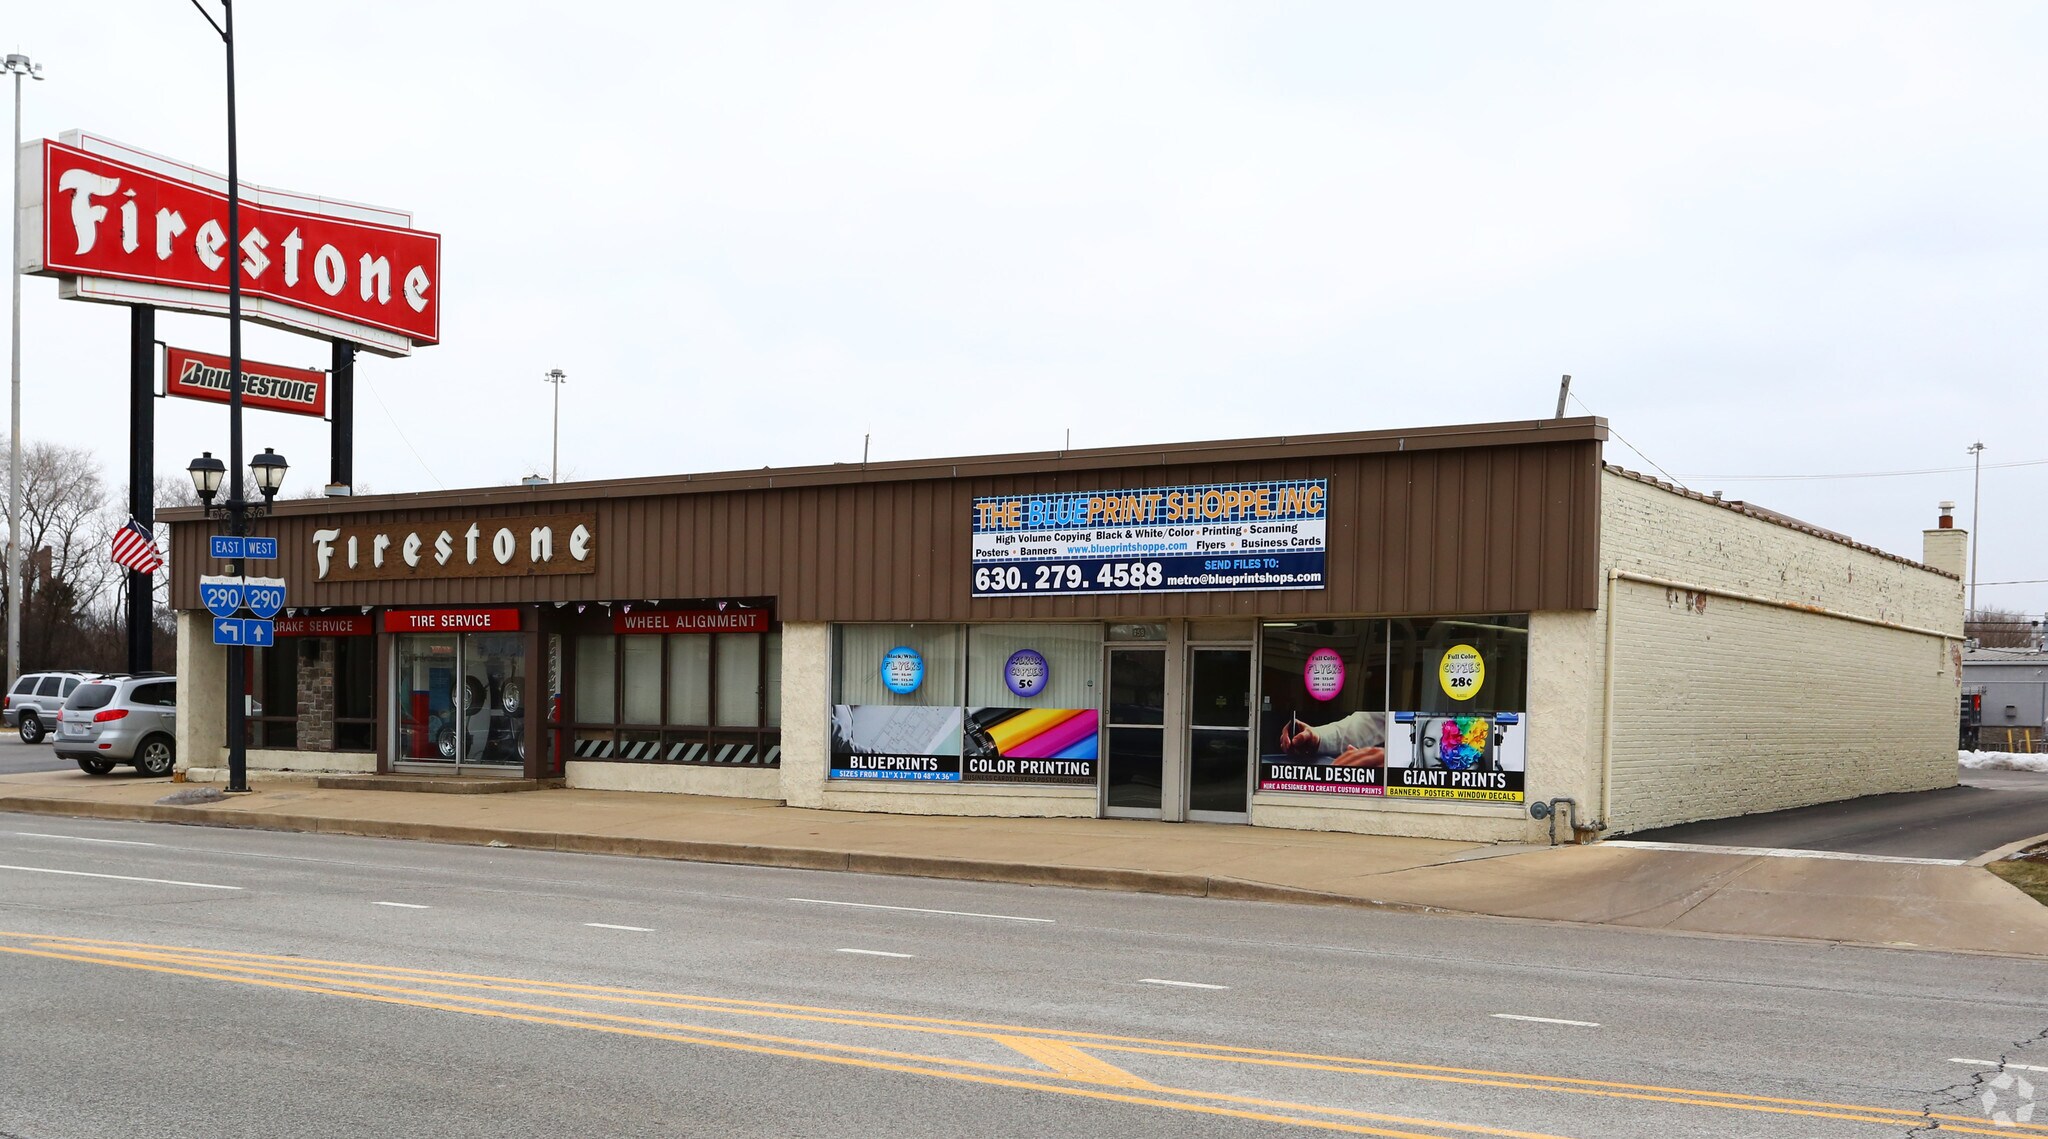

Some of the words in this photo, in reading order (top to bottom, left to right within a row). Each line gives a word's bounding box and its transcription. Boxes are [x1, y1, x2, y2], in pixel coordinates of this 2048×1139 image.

[58, 168, 431, 313] Firestone
[976, 501, 1021, 529] THE
[1028, 494, 1162, 527] BLUEPRINT
[995, 535, 1016, 545] High
[1018, 533, 1052, 543] Volume
[1054, 531, 1092, 543] Copying
[1096, 530, 1123, 540] Black
[1125, 530, 1133, 539] &
[1202, 526, 1242, 537] Printing
[1250, 523, 1298, 534] Scanning
[216, 541, 239, 553] EAST
[249, 541, 272, 554] WEST
[312, 522, 591, 580] Firestone
[975, 548, 1009, 558] Posters
[1020, 547, 1057, 556] Banners
[1067, 541, 1188, 555] www.blueprintshoppe.com
[1196, 540, 1226, 551] Flyers
[1241, 538, 1288, 548] Business
[1291, 536, 1322, 546] Cards
[1204, 560, 1231, 570] SEND
[1233, 559, 1261, 570] FILES
[1263, 558, 1279, 569] TO:
[975, 566, 1028, 591] 630.
[1035, 564, 1089, 589] 279.
[1096, 562, 1163, 588] 4588
[1167, 572, 1322, 586] metro@blueprintshops.com
[207, 588, 239, 608] 290
[250, 589, 281, 609] 290
[309, 620, 353, 632] SERVICE
[410, 615, 435, 627] TIRE
[441, 614, 491, 627] SERVICE
[625, 616, 669, 628] WHEEL
[676, 614, 757, 628] ALIGNMENT
[884, 661, 922, 671] FLYERS
[1010, 667, 1044, 677] COPIES
[1307, 663, 1343, 675] FLYERS
[1443, 662, 1480, 674] COPIES
[1019, 679, 1033, 689] 5¢
[850, 756, 938, 771] BLUEPRINTS
[969, 758, 1015, 773] COLOR
[1020, 760, 1090, 776] PRINTING
[1271, 765, 1321, 780] DIGITAL
[1325, 767, 1375, 783] DESIGN
[1403, 770, 1447, 786] GIANT
[1452, 771, 1506, 788] PRINTS
[1281, 783, 1307, 791] DESIGNER
[1316, 785, 1337, 793] CREATE
[1337, 786, 1360, 794] CUSTOM
[1361, 787, 1382, 795] PRINTS
[1389, 787, 1421, 796] BANNERS
[1424, 789, 1455, 797] POSTERS
[1457, 790, 1487, 799] WINDOW
[1488, 792, 1516, 800] DECALS
